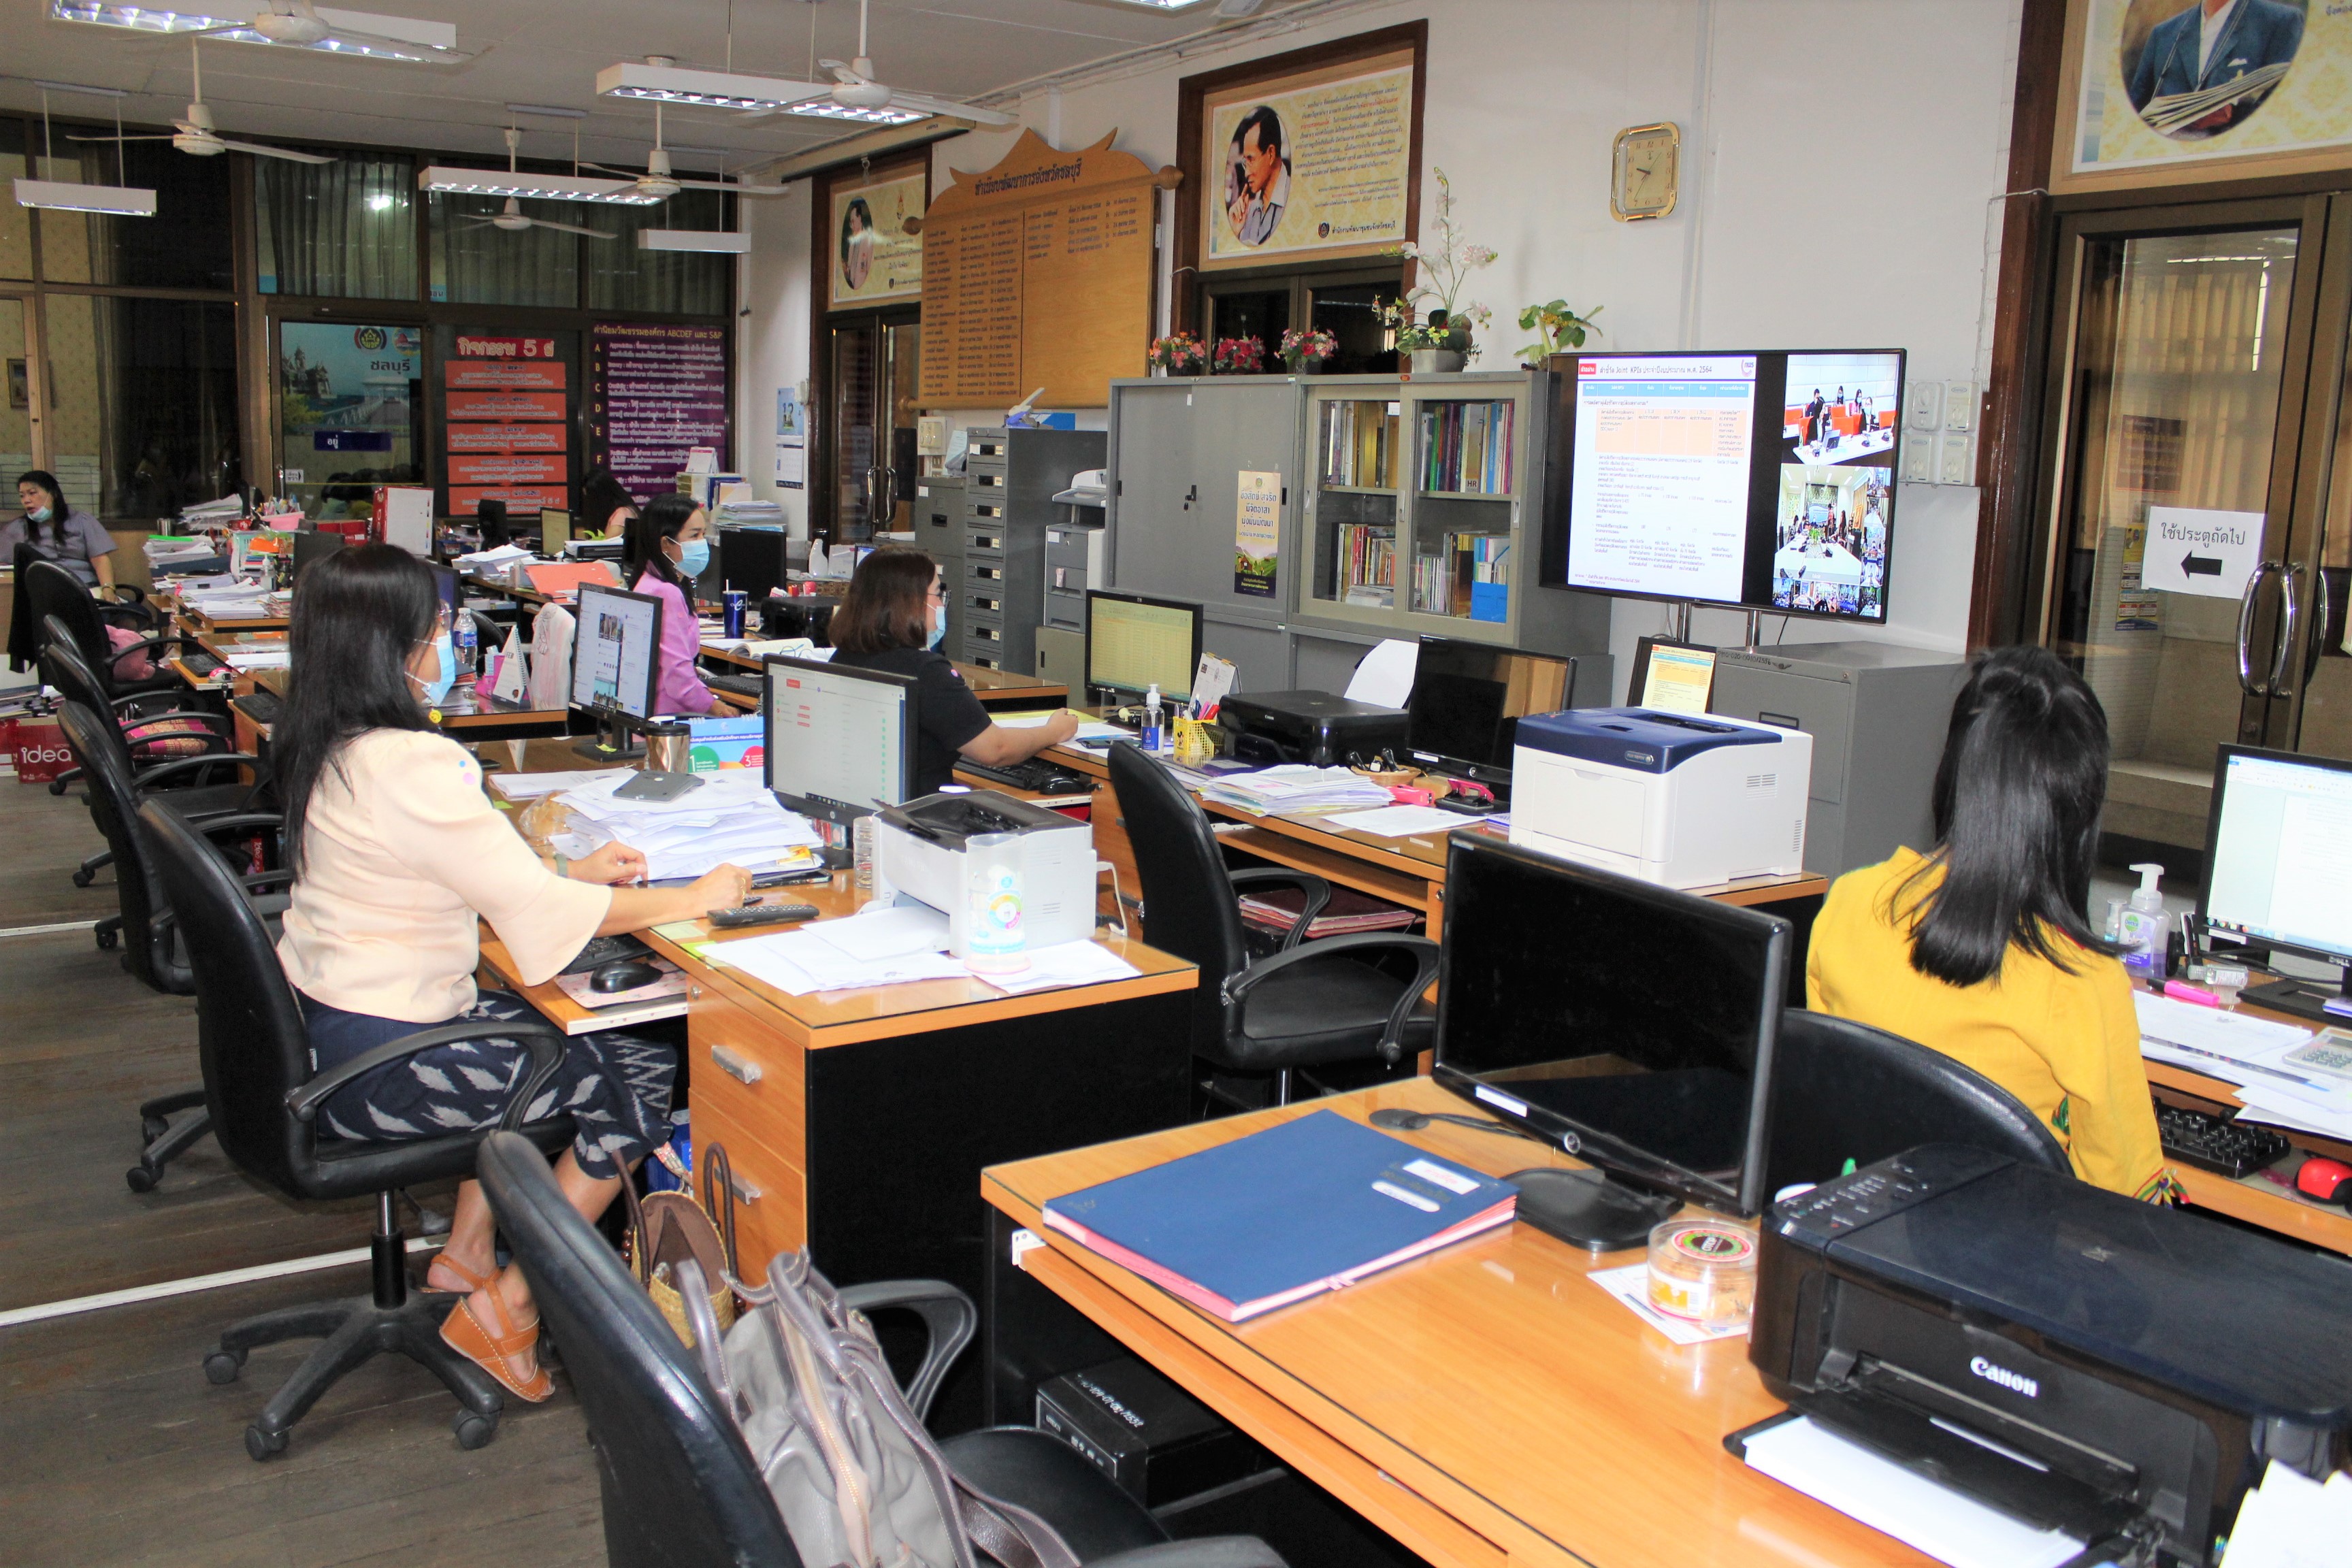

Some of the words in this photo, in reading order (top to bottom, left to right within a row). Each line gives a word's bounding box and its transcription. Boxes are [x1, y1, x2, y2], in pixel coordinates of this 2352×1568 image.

[370, 358, 411, 375] ชลบุรี
[1616, 365, 1628, 374] Joint
[1630, 365, 1642, 374] KPIs
[1699, 365, 1712, 374] 2564
[1467, 479, 1477, 489] HR
[2161, 522, 2246, 549] ใช้ประตูถัดไป
[20, 745, 72, 764] idea
[2125, 918, 2139, 927] Dettol
[1970, 1356, 2038, 1398] Canon
